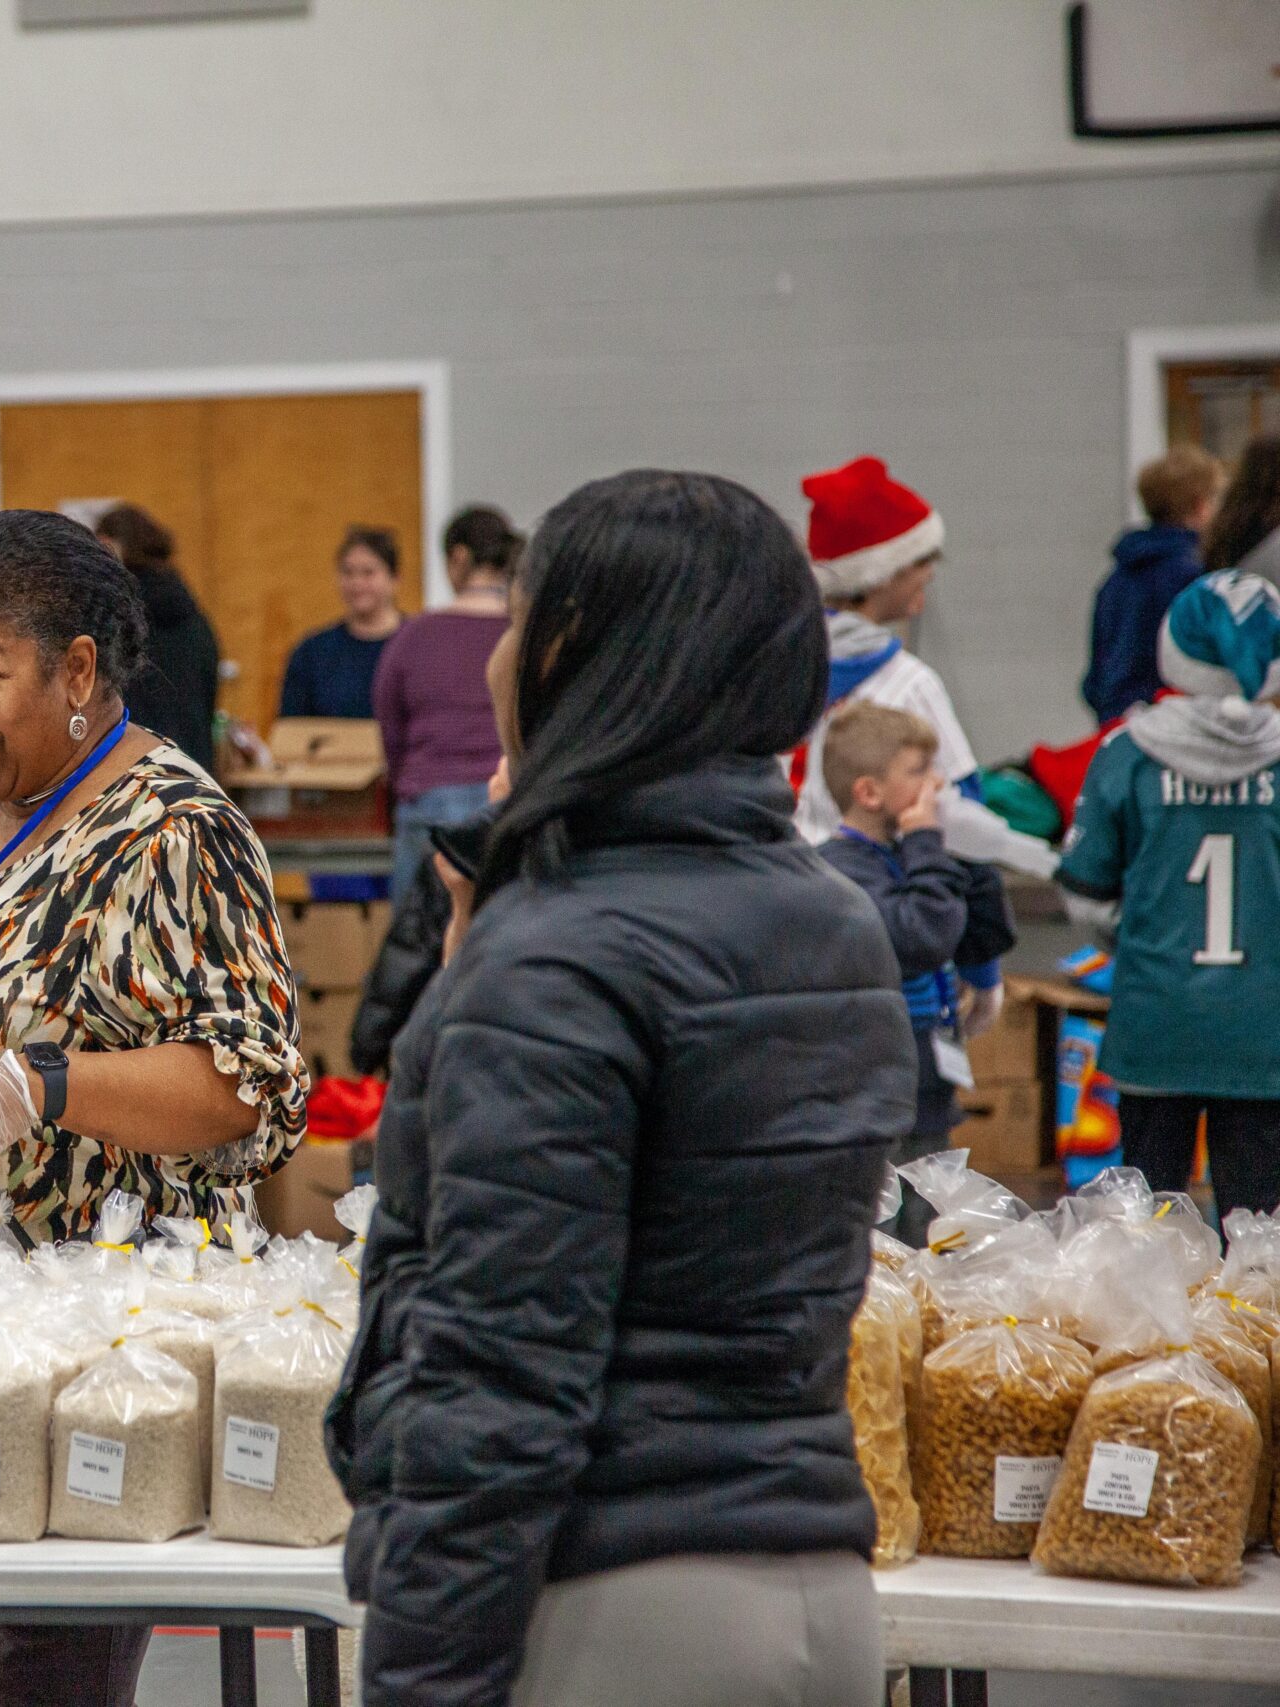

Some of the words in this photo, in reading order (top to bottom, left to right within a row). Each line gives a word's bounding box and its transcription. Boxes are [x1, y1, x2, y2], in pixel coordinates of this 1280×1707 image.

[1186, 833, 1244, 965] 1
[248, 1427, 276, 1442] HOPE
[95, 1442, 123, 1458] HOPE
[1125, 1453, 1153, 1465] HOPE
